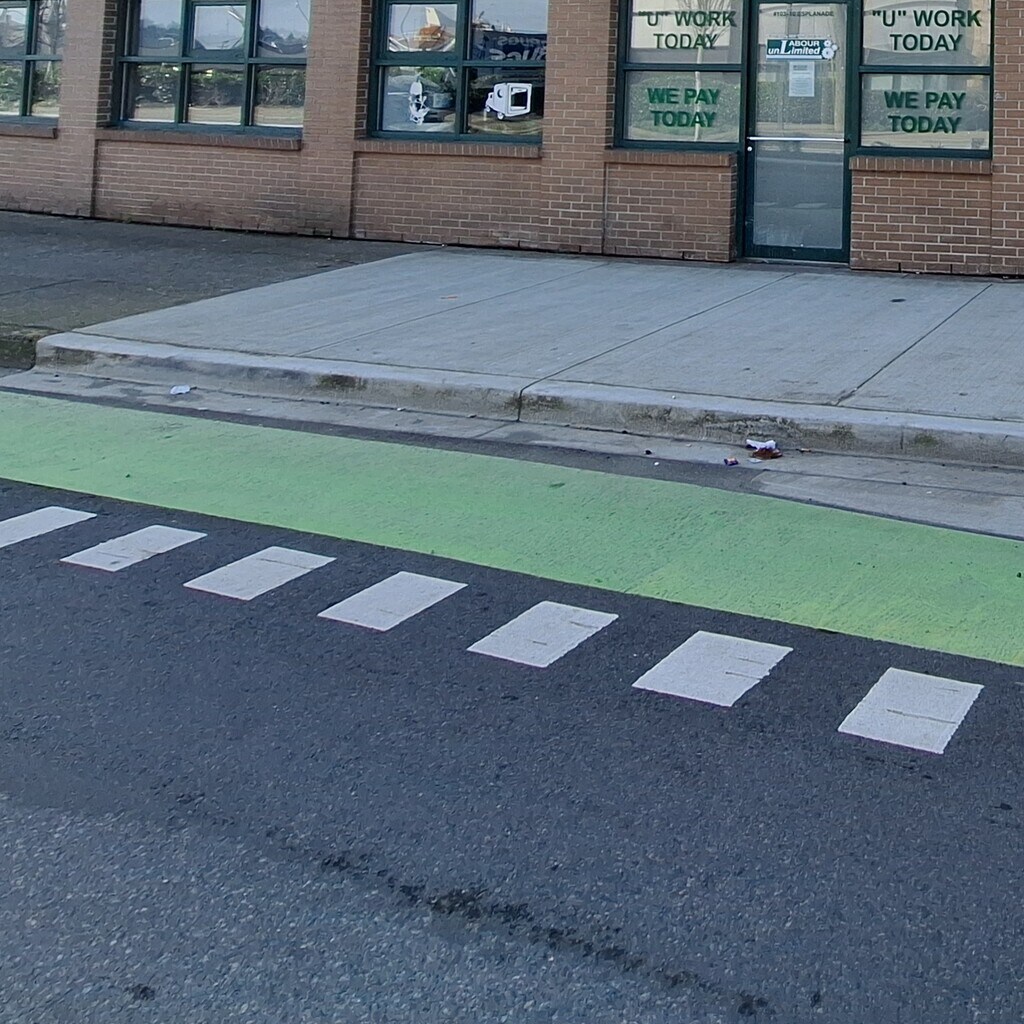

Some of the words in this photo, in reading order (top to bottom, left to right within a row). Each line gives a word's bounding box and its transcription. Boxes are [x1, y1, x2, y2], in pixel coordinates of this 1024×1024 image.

[674, 10, 737, 28] WORK
[872, 9, 907, 27] "U"
[912, 9, 982, 28] WORK
[653, 32, 719, 50] TODAY
[780, 39, 820, 55] LABOUR
[889, 33, 963, 52] TODAY
[646, 87, 680, 105] WE
[684, 88, 720, 105] PAY
[883, 90, 919, 109] WE
[925, 91, 967, 110] PAY
[650, 110, 718, 128] TODAY
[887, 114, 962, 134] TODAY
